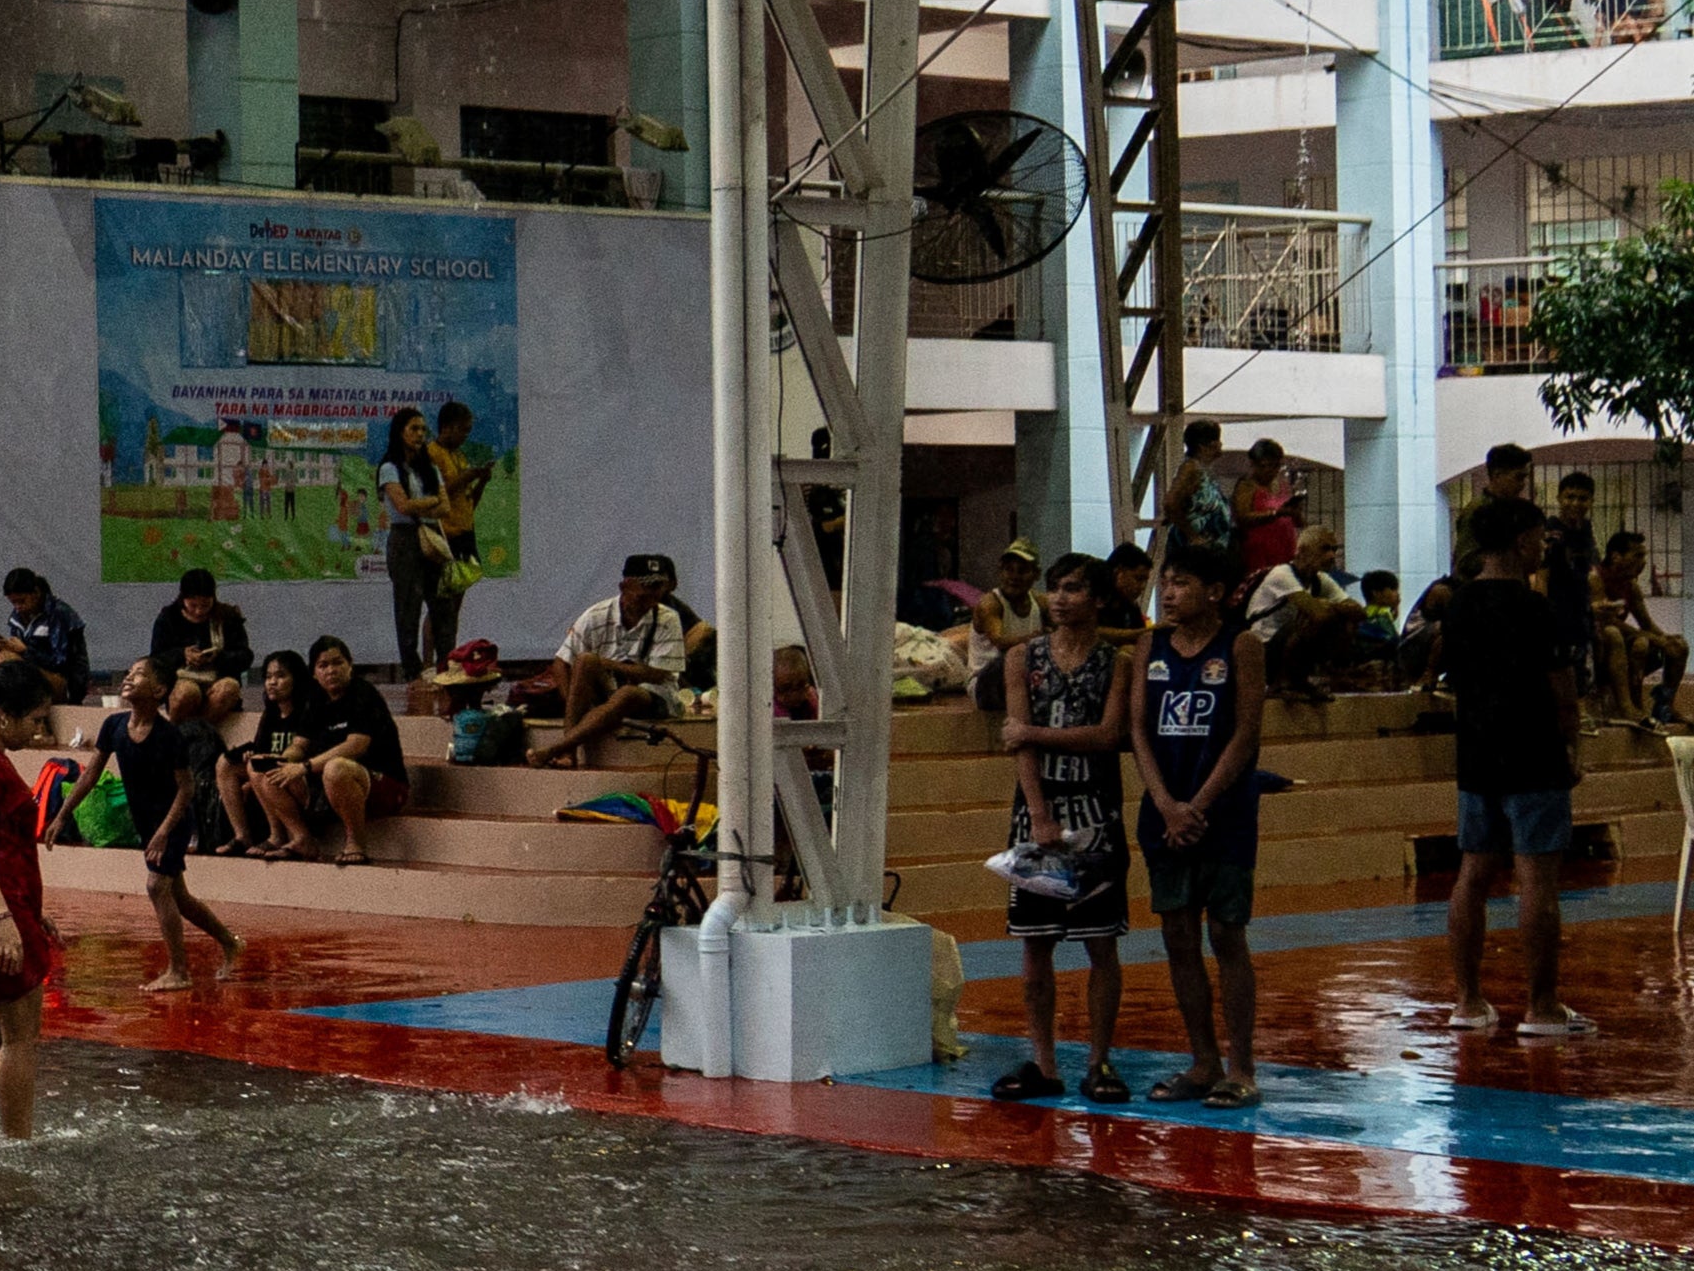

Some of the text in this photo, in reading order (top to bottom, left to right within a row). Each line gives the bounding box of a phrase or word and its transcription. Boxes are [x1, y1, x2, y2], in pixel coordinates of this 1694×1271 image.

[132, 246, 495, 280] MALANDAY ELEMENTARY SCHOOL
[250, 387, 284, 401] PARA
[288, 387, 305, 401] SA
[309, 388, 365, 401] MATATAG
[371, 389, 387, 402] NA
[215, 402, 247, 415] TARA
[252, 403, 268, 415] NA
[273, 403, 357, 417] MAGBRIGADA
[362, 404, 379, 418] NA
